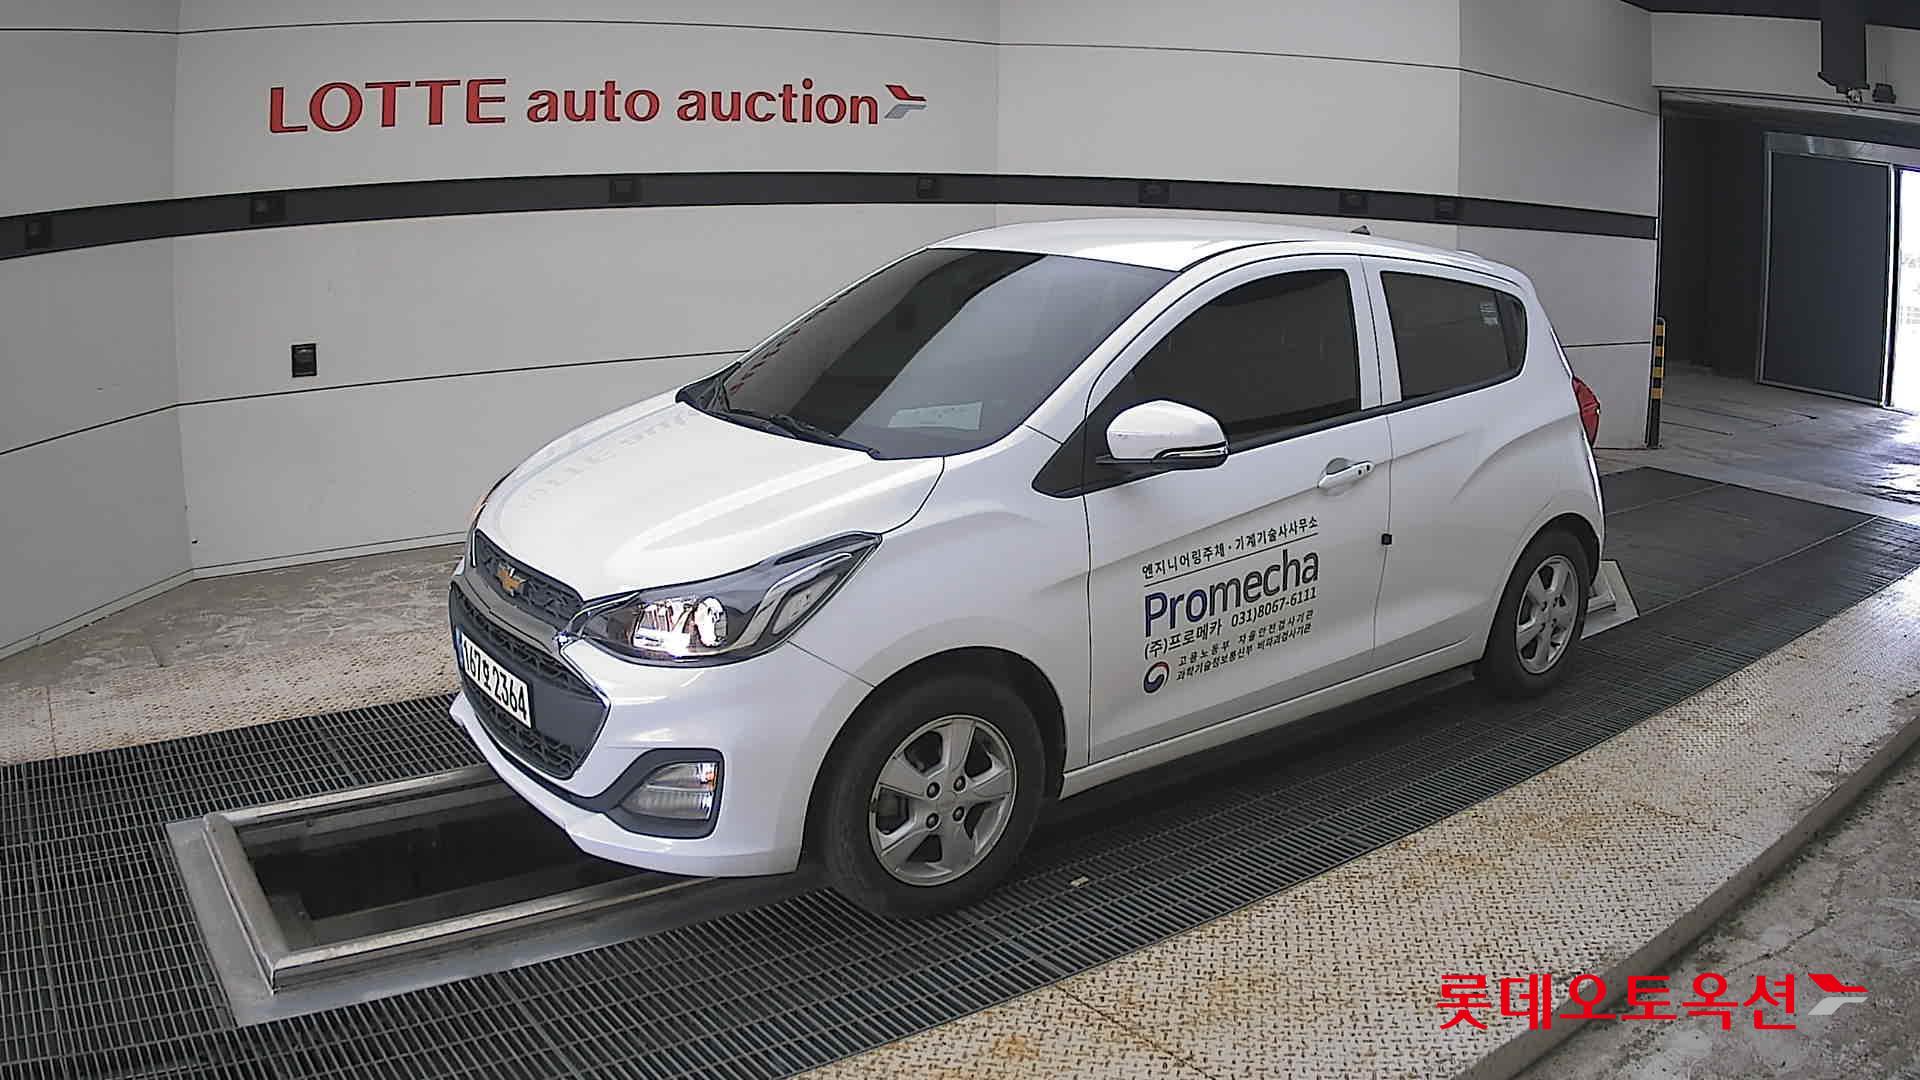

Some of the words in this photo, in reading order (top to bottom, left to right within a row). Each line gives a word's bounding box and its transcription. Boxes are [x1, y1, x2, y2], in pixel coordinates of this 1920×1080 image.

[270, 78, 506, 133] LOTTE
[527, 81, 660, 124] auto
[676, 78, 879, 125] auction
[1144, 619, 1222, 660] (주)프로메카
[1231, 587, 1316, 628] 031)8067-6111
[1145, 549, 1319, 638] Promecha
